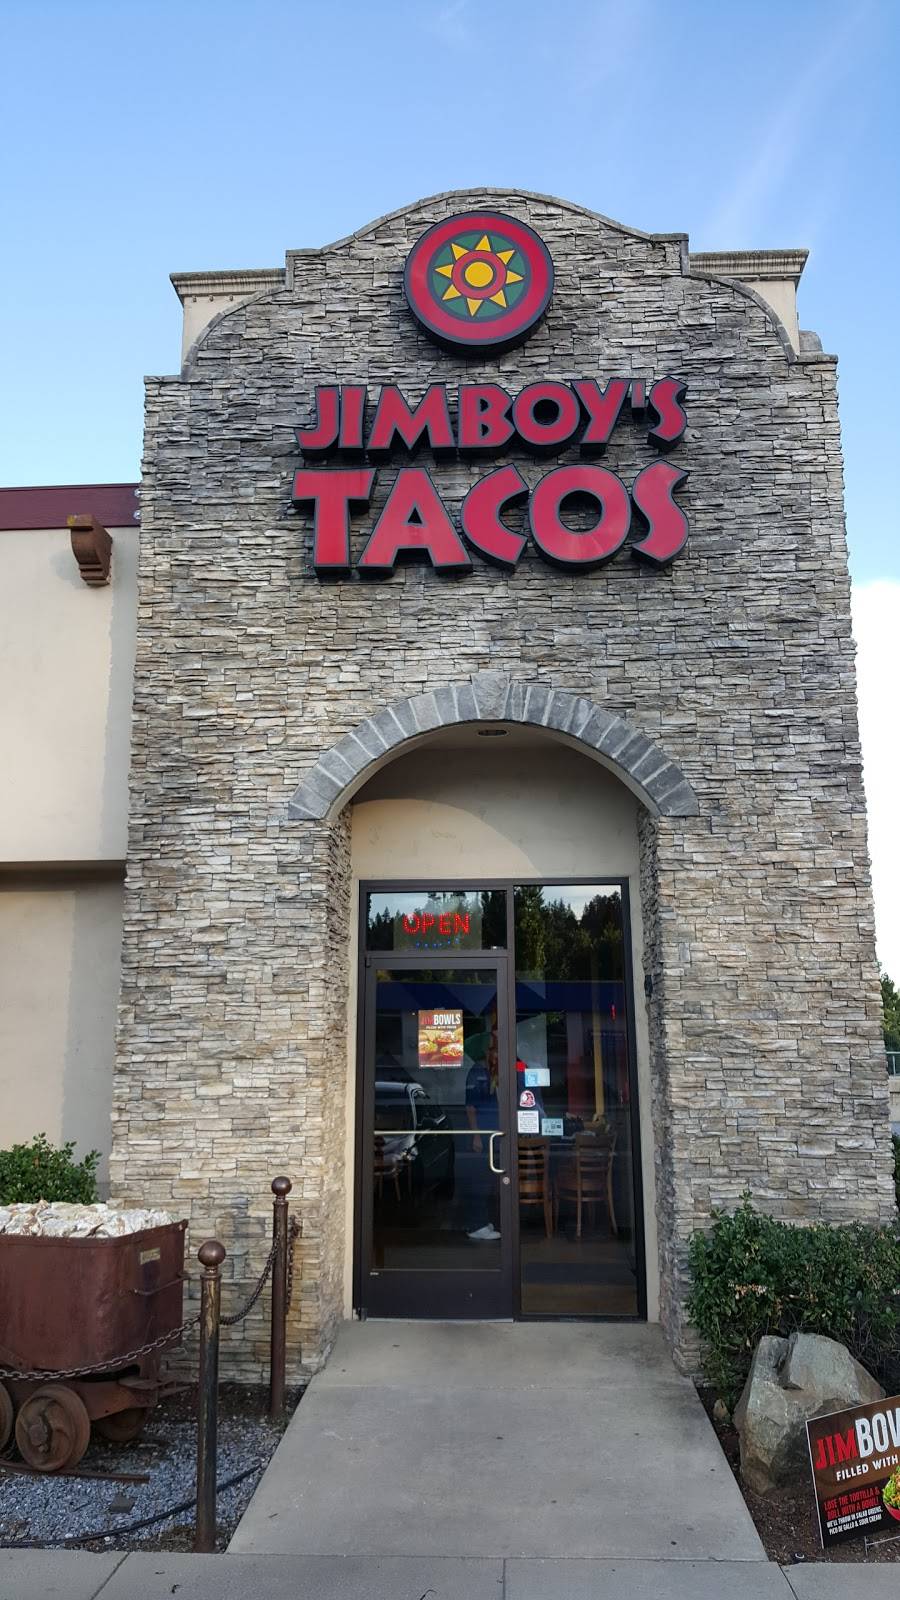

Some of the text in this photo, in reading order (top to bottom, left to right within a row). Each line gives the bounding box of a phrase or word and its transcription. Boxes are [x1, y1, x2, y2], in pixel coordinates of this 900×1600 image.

[295, 376, 688, 457] JIMBOY'S
[292, 459, 690, 573] TACOS
[402, 912, 470, 935] OPEN
[836, 1454, 898, 1481] FILLED WITH
